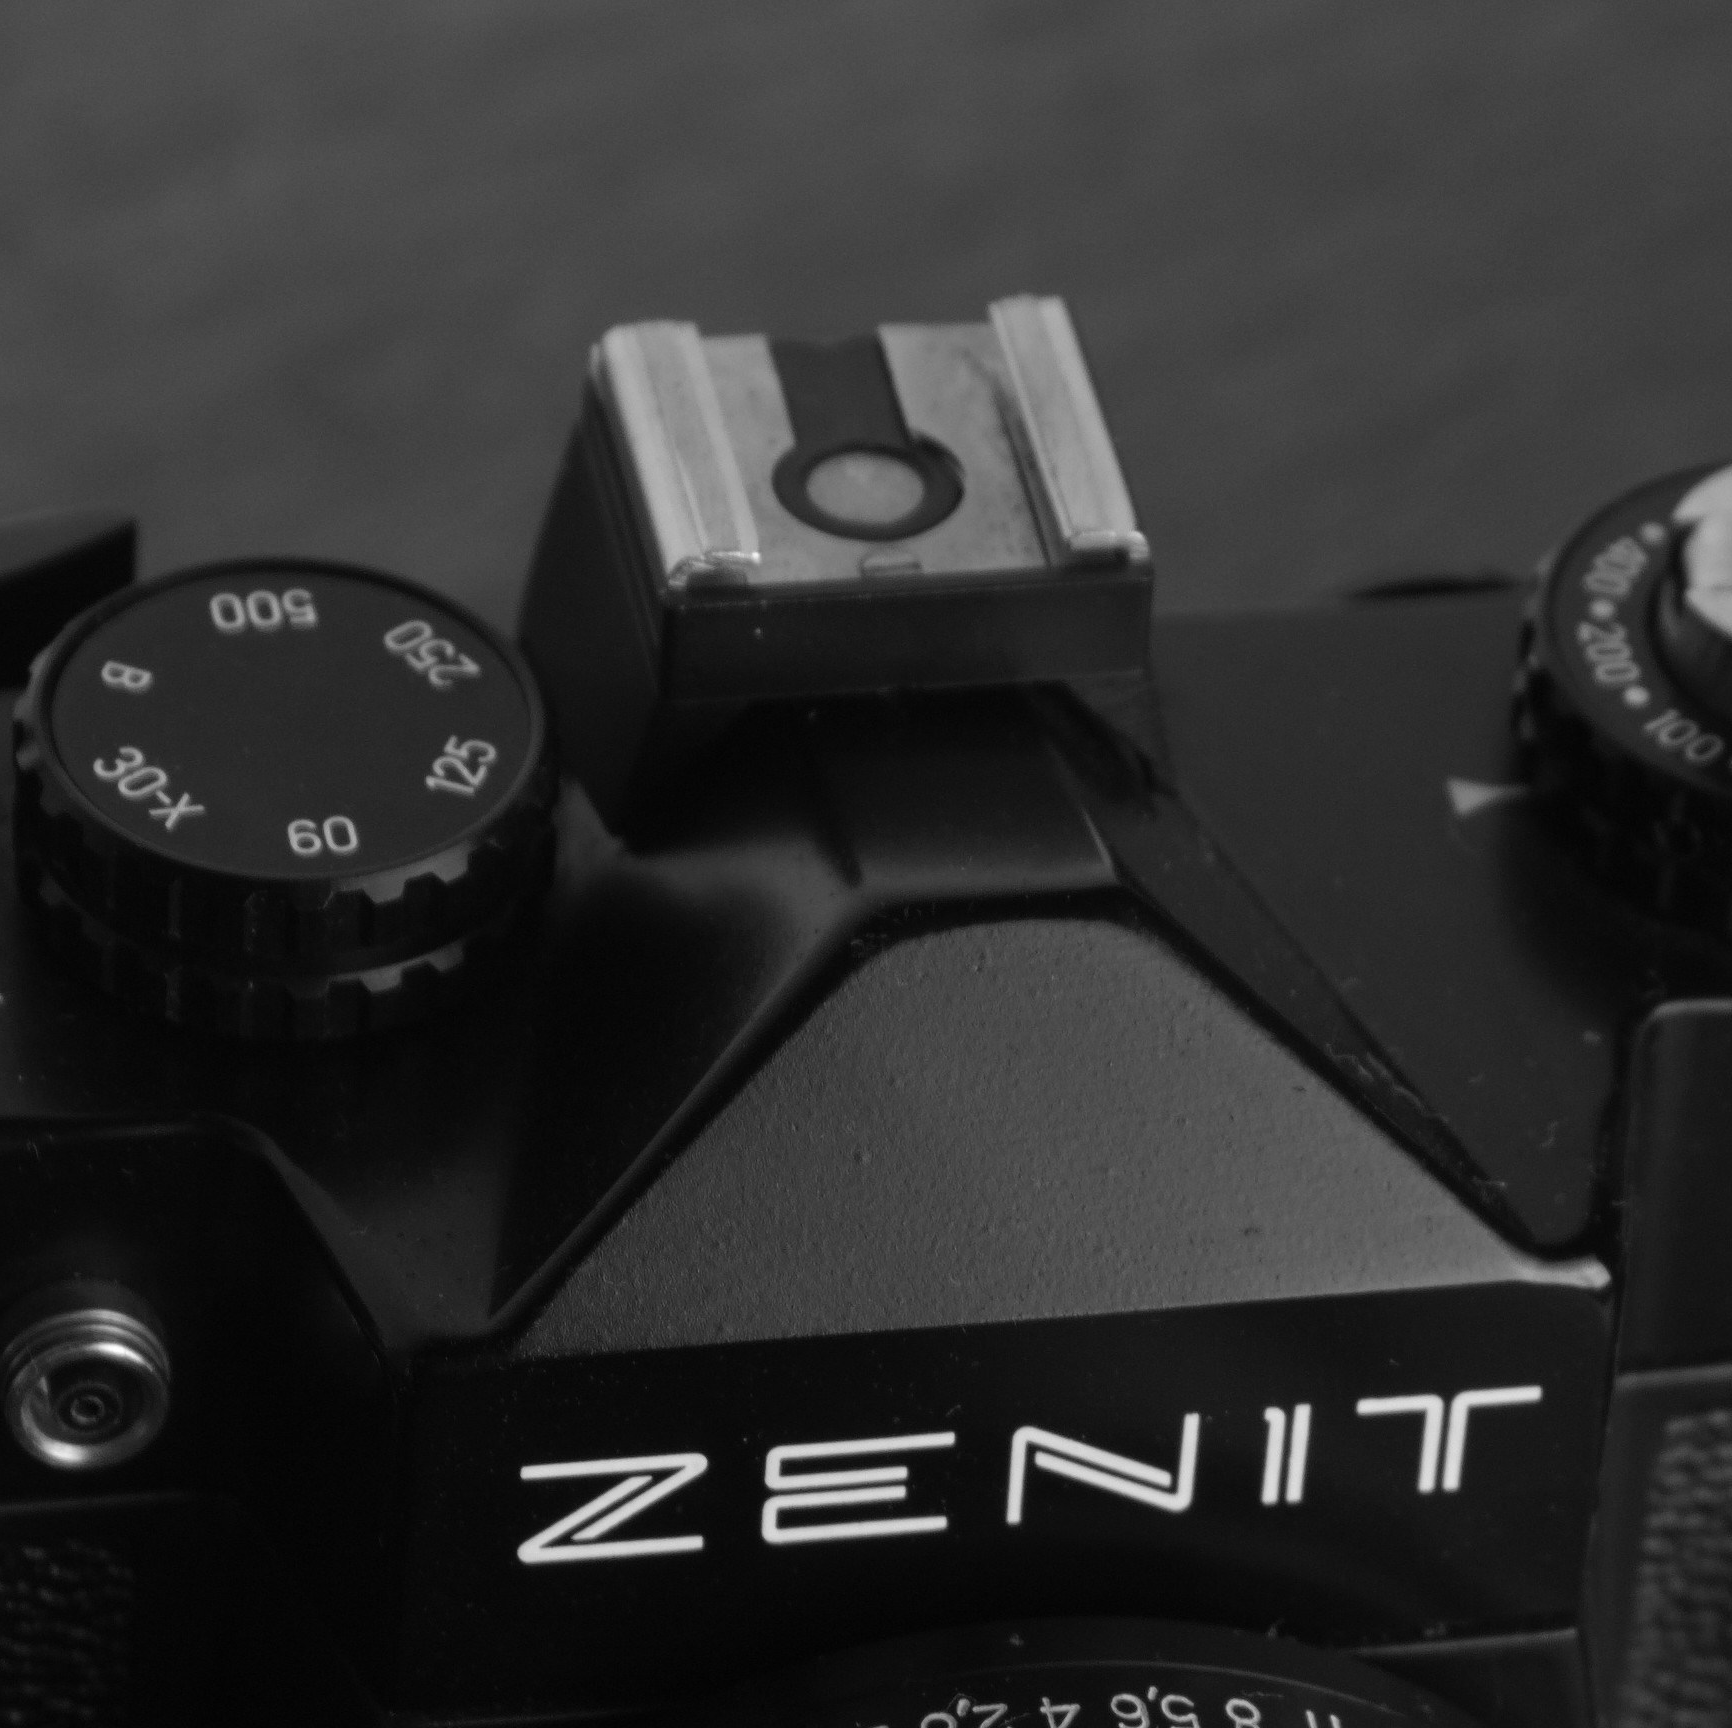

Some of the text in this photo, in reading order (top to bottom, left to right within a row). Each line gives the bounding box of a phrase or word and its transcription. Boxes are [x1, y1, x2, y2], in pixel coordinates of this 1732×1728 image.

[208, 588, 318, 632] 500
[100, 660, 153, 692] B
[382, 619, 481, 688] 250
[1576, 619, 1642, 687] 200
[1643, 707, 1725, 764] 100
[424, 735, 498, 796] 125
[286, 814, 360, 856] 60
[516, 1384, 1544, 1565] ZENIT
